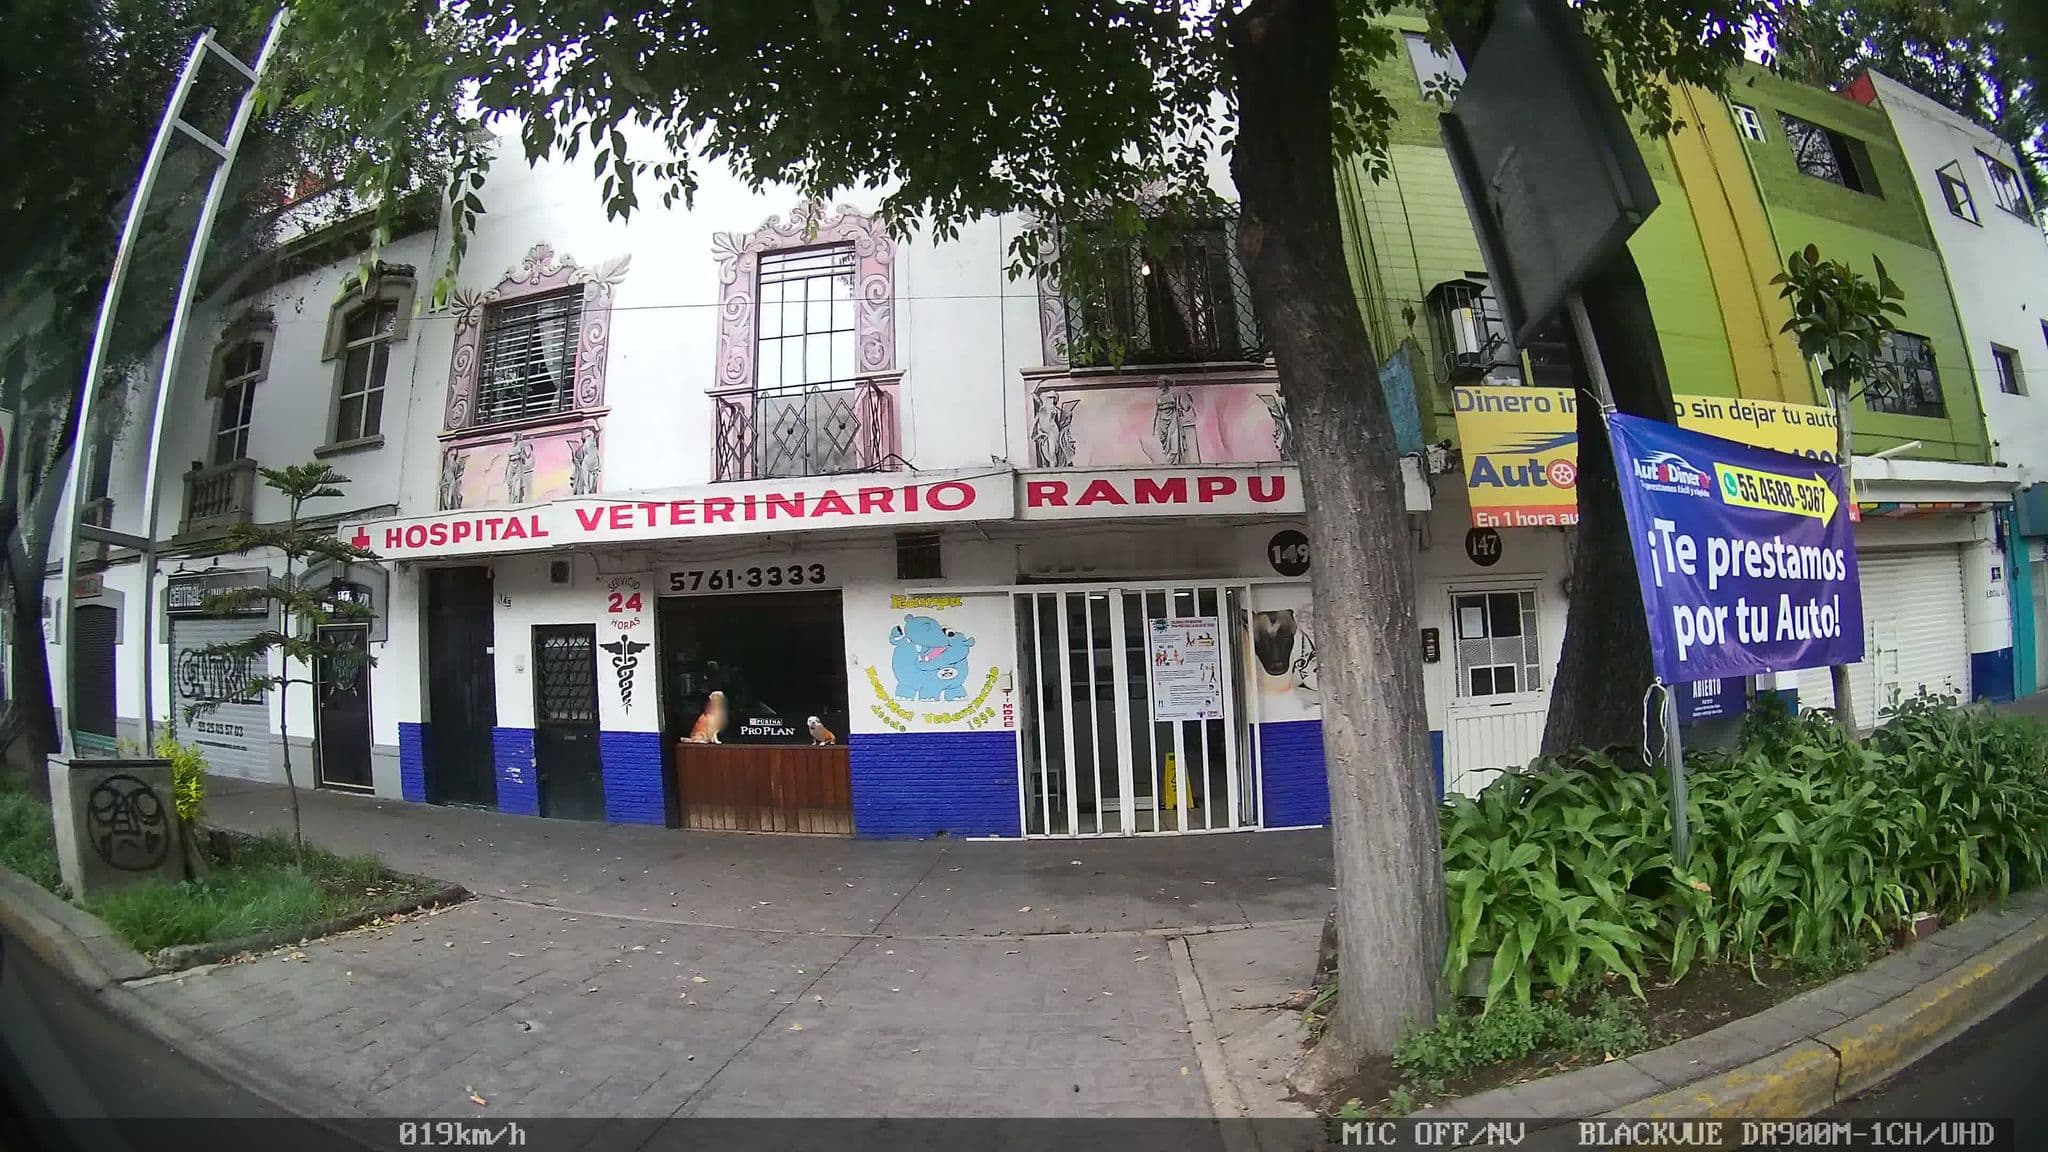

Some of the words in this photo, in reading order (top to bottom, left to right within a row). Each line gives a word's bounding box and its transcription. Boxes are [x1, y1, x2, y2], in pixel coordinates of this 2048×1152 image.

[1454, 389, 1551, 413] Dinero
[1692, 399, 1723, 419] sin
[1729, 399, 1776, 428] dejar
[1783, 406, 1801, 424] tu
[1737, 473, 1759, 503] 55
[1759, 477, 1826, 513] 4588-9367
[386, 515, 549, 549] HOSPITAL
[575, 482, 976, 532] VETERINARIO
[1027, 476, 1286, 507] RAMPU
[1477, 512, 1499, 528] En
[1503, 512, 1513, 527] 1
[1515, 510, 1556, 526] hora
[1472, 535, 1497, 556] 147
[1648, 518, 1697, 587] ¡Te
[1708, 536, 1846, 590] prestamos
[608, 576, 641, 592] SERVICIO
[608, 592, 642, 612] 24
[611, 616, 641, 630] HORAS
[1673, 605, 1728, 661] por
[1736, 597, 1769, 644] tu
[1776, 594, 1841, 642] Auto!
[1693, 678, 1722, 698] ABIERTO
